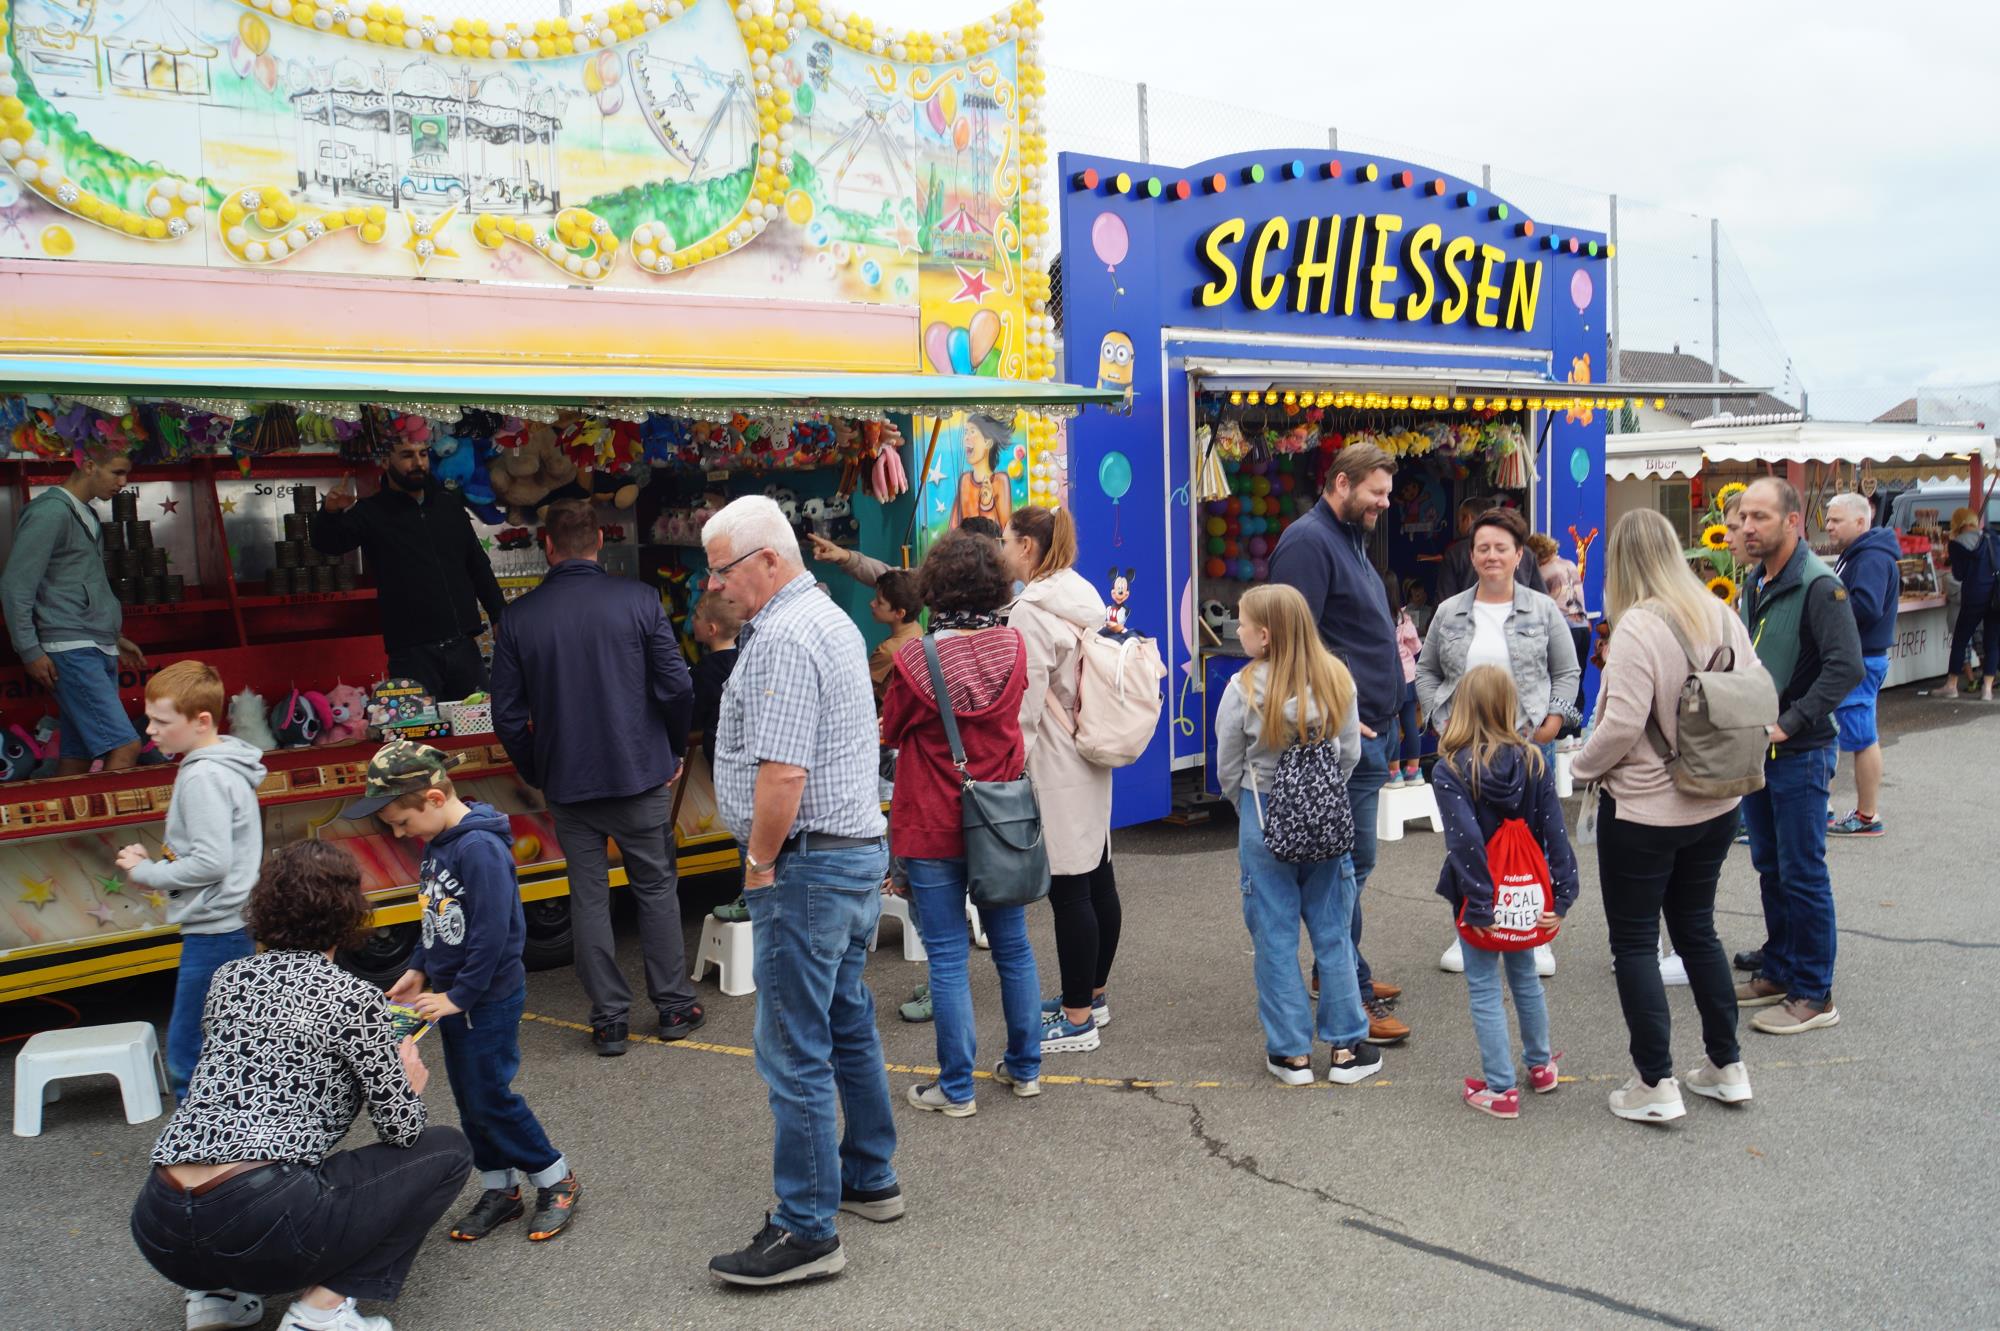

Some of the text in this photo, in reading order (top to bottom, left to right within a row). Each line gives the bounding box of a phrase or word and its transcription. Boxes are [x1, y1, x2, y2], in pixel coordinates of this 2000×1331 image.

[1202, 213, 1543, 332] SCHIESSEN
[1645, 459, 1677, 470] Biber
[254, 482, 303, 498] So ge
[1888, 629, 1927, 660] HERER
[437, 868, 466, 897] BOY
